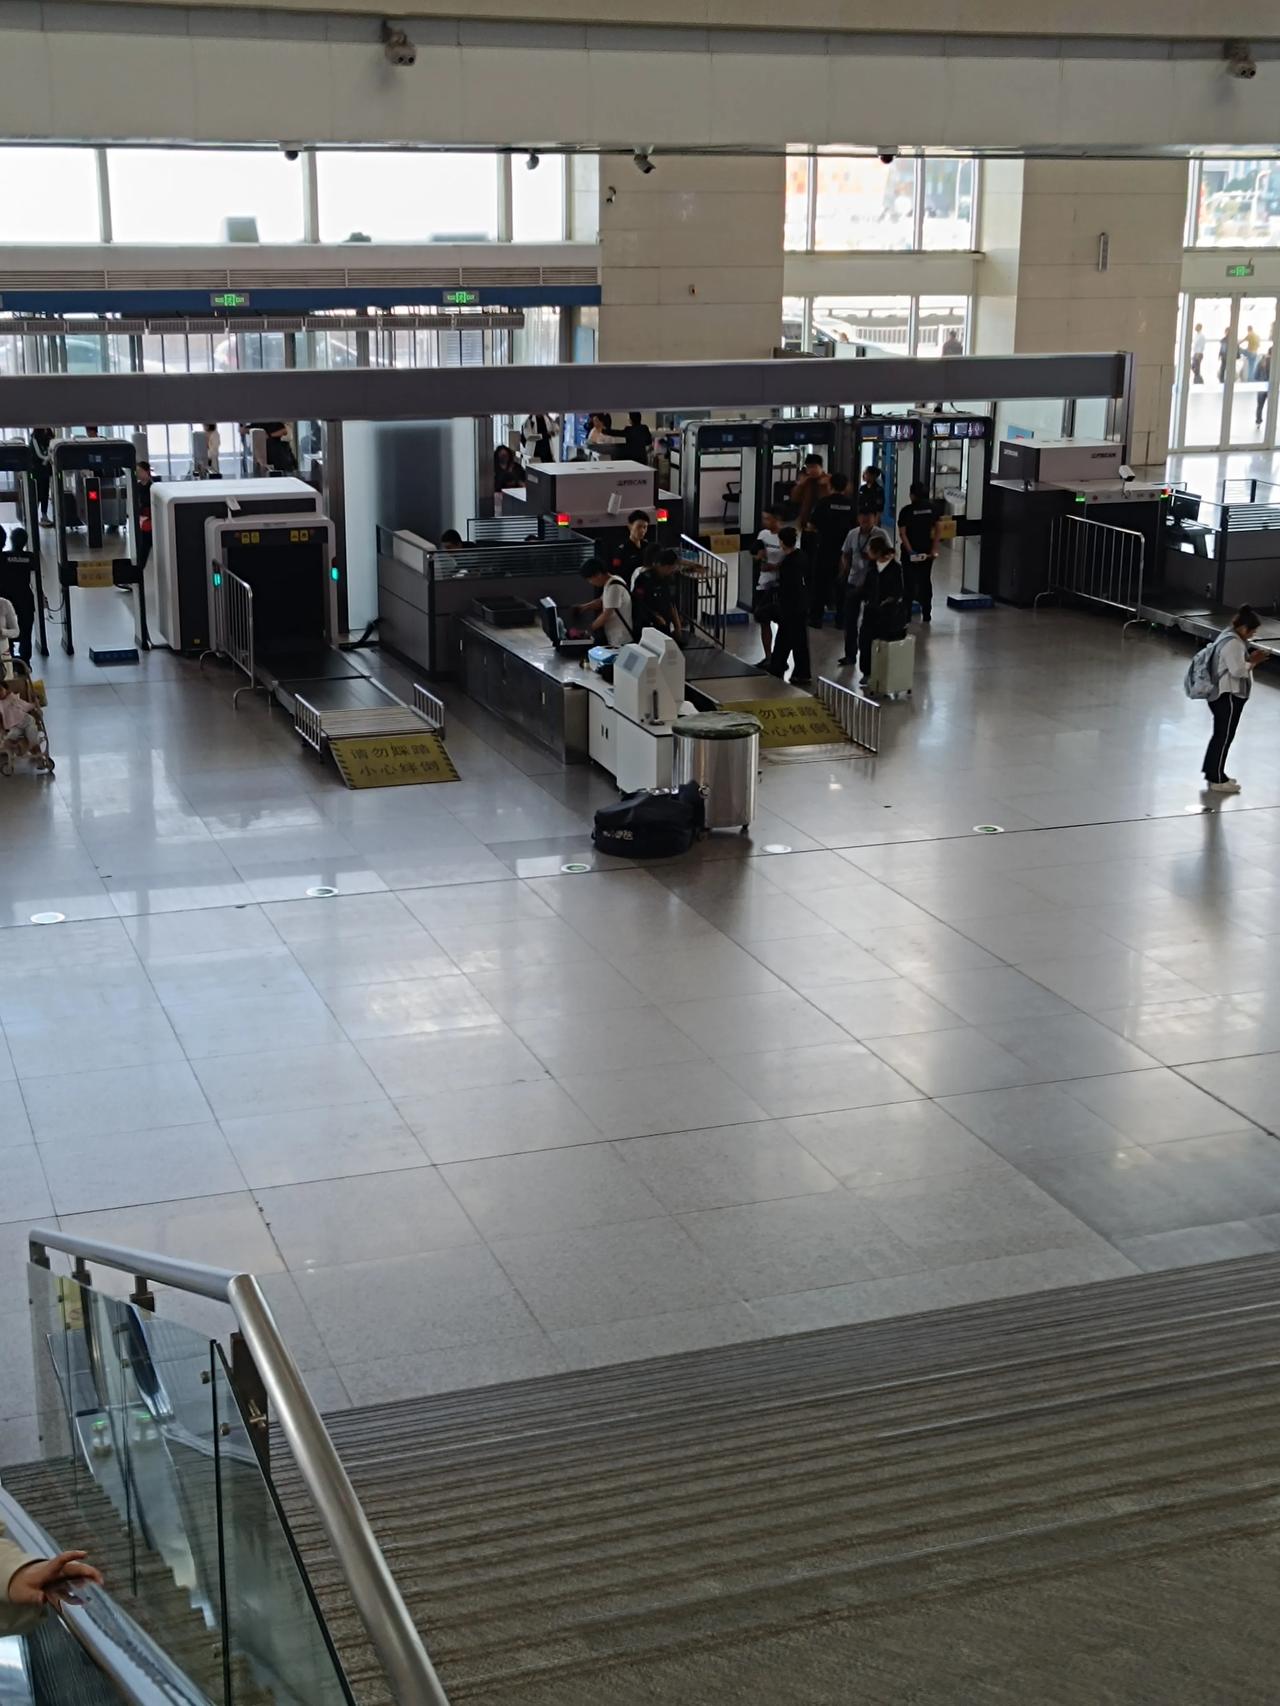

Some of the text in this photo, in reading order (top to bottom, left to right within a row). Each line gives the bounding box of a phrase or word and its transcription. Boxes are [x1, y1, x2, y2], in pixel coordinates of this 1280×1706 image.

[742, 706, 818, 720] 勿踩踏
[360, 760, 439, 776] 小心绊倒
